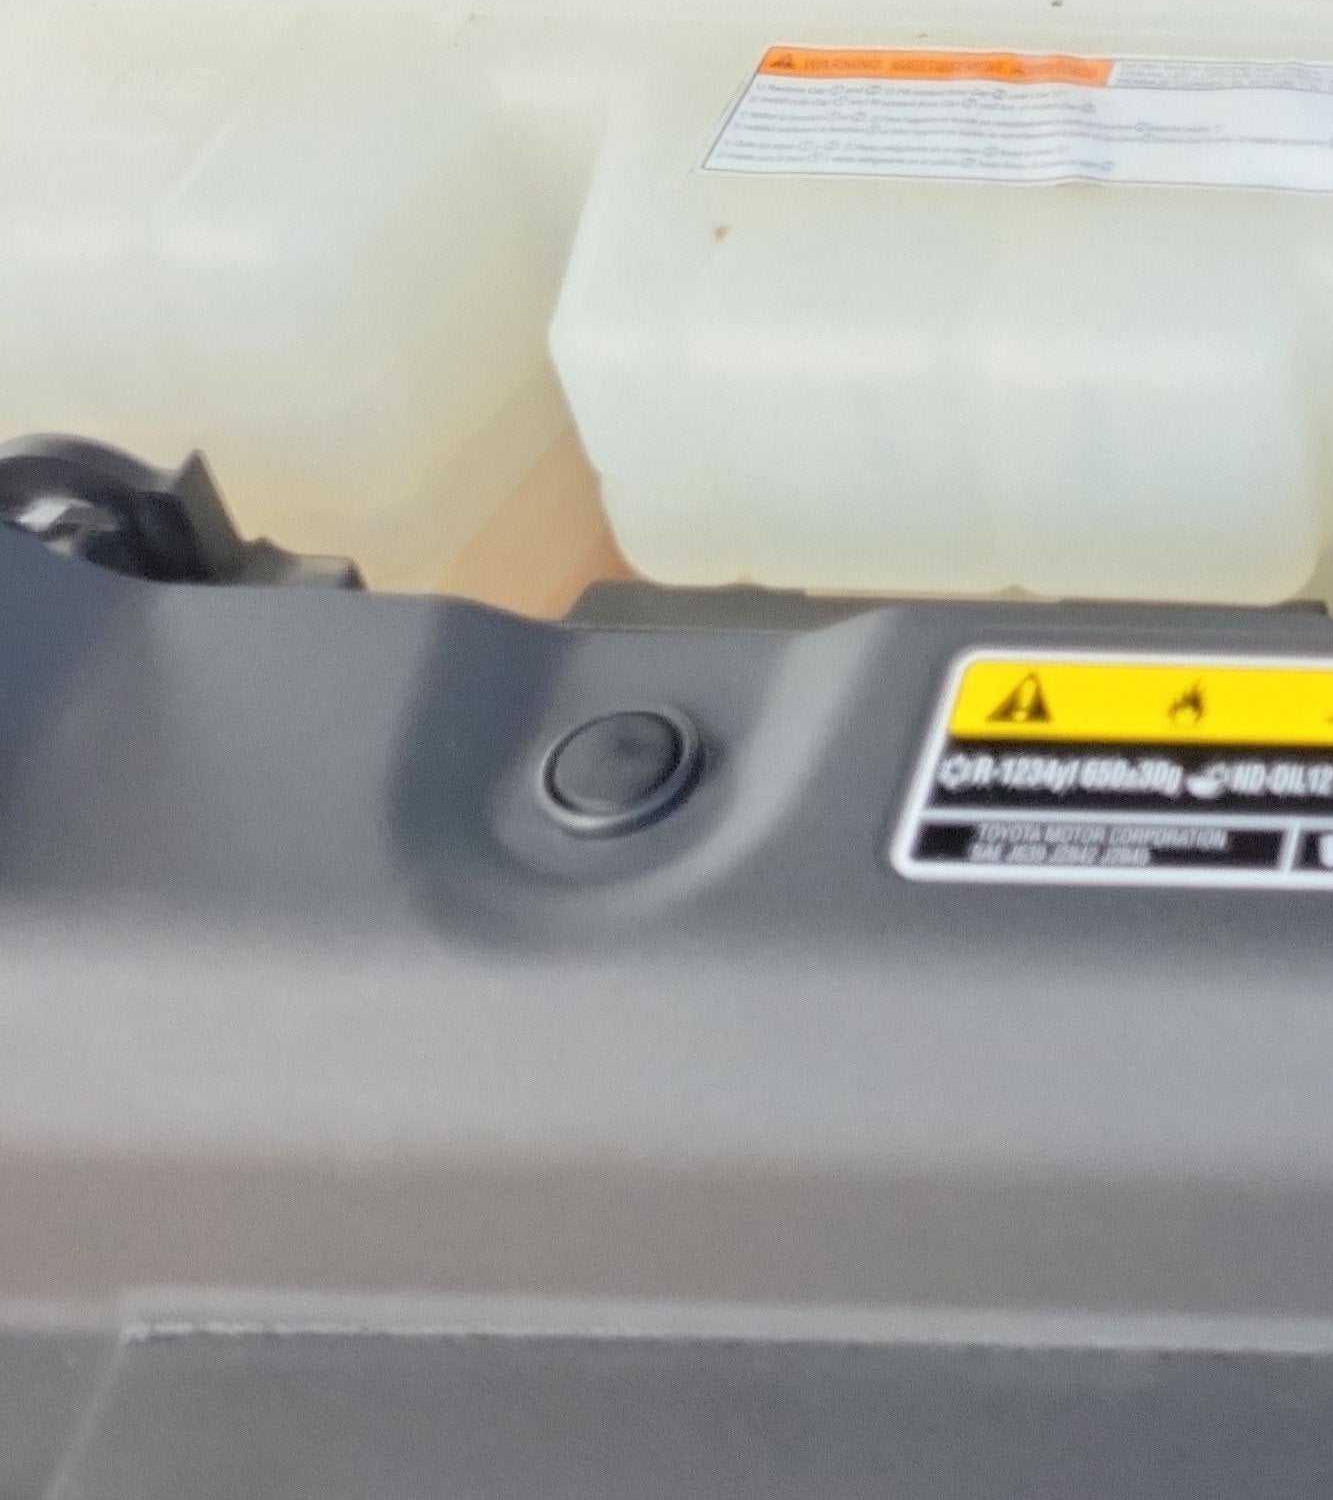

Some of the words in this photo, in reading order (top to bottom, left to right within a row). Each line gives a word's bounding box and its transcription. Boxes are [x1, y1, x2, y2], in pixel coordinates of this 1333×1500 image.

[979, 822, 1042, 843] TOYOTA
[1044, 823, 1106, 844] MOTOR
[1107, 825, 1228, 850] CORPORATION
